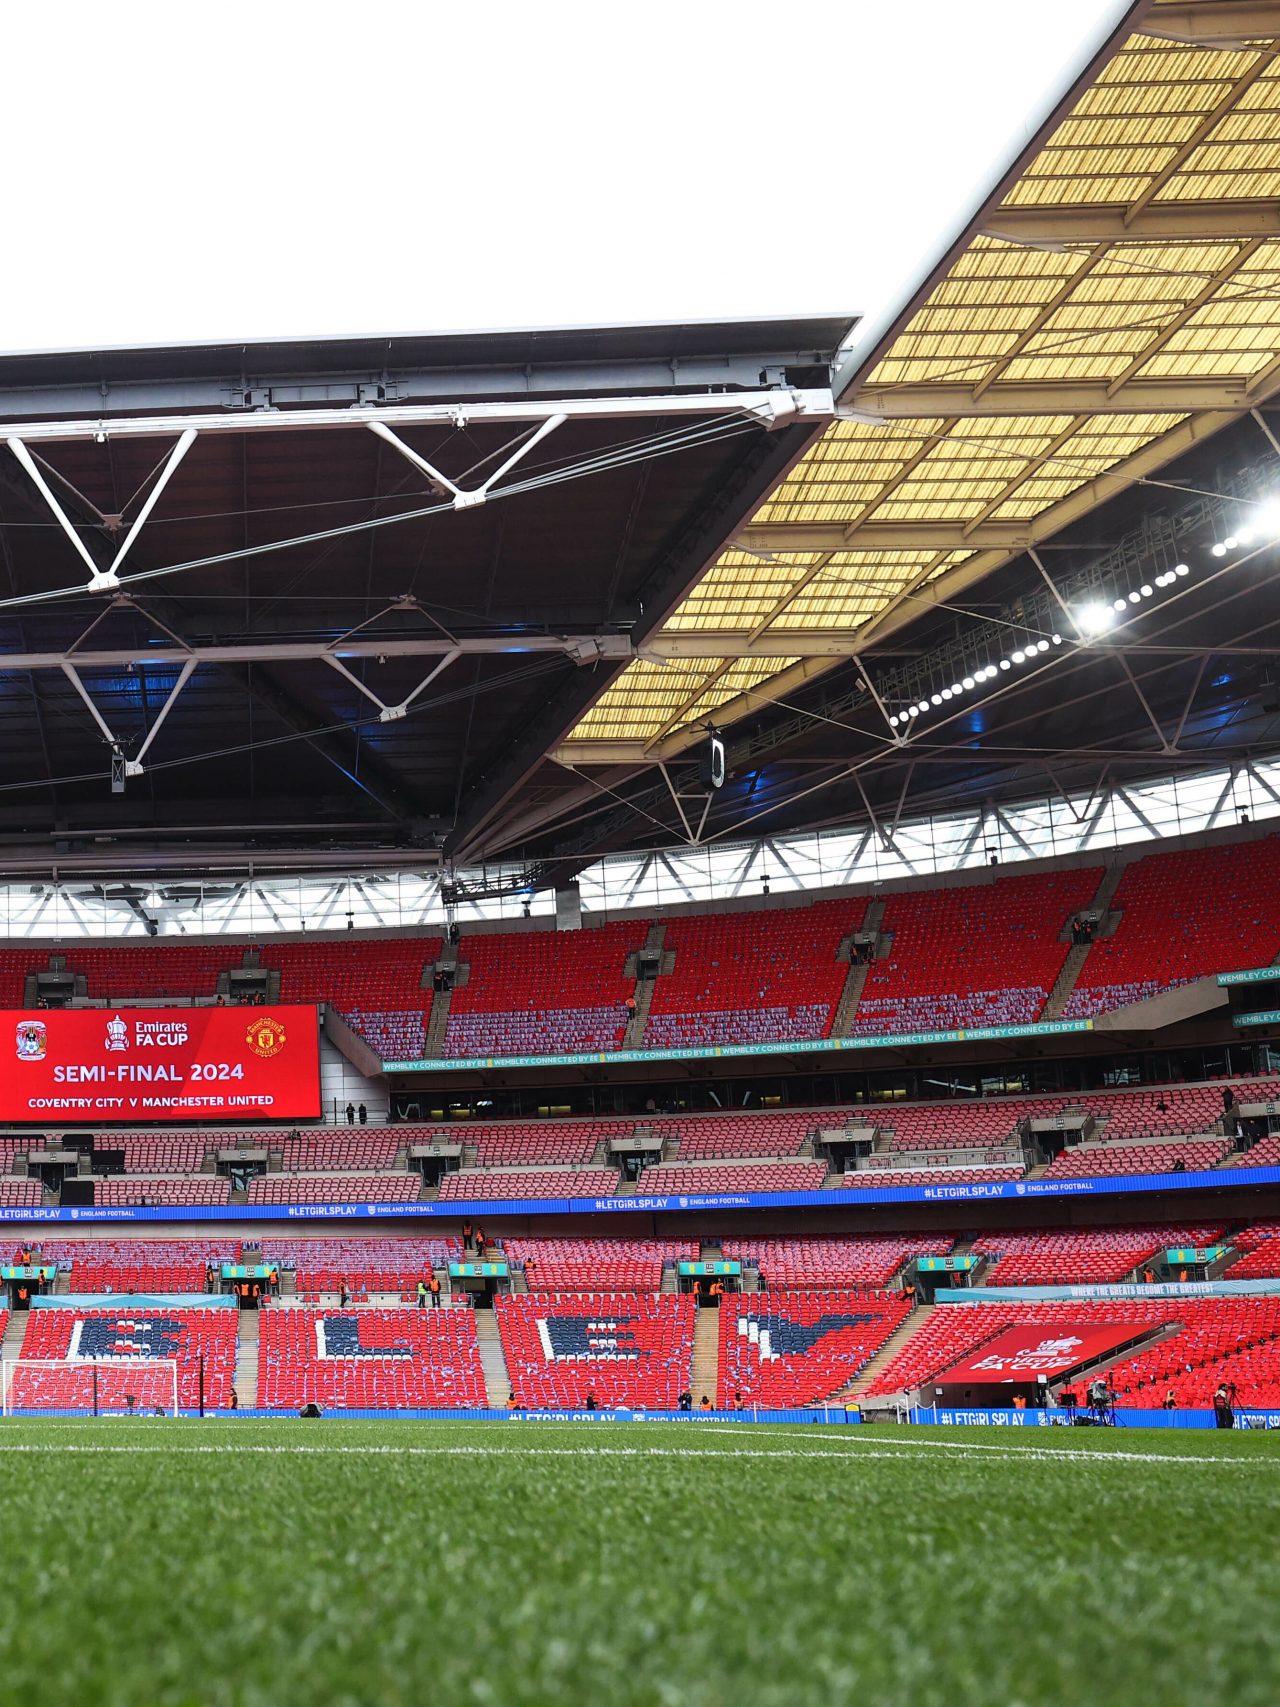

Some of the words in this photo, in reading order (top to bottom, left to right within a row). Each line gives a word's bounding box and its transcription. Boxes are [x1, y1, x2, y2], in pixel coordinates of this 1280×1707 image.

[1219, 972, 1261, 983] WEMBLEY
[1233, 1014, 1275, 1024] WEMBLEY
[136, 1021, 188, 1033] Emirates
[966, 1028, 1006, 1038] WEMBLEY
[1007, 1024, 1060, 1035] CONNECTED
[136, 1034, 154, 1046] FA
[157, 1034, 188, 1046] CUP
[842, 1038, 880, 1047] WEMBLEY
[882, 1034, 933, 1044] CONNECTED
[722, 1046, 760, 1055] WEMBLEY
[761, 1043, 811, 1052] CONNECTED
[494, 1058, 529, 1066] WEMBLEY
[530, 1056, 577, 1064] CONNECTED
[607, 1052, 643, 1061] WEMBLEY
[644, 1050, 692, 1059] CONNECTED
[384, 1062, 418, 1070] WEMBLEY
[420, 1060, 466, 1069] CONNECTED
[53, 1064, 183, 1083] SEMI-FINAL
[190, 1063, 245, 1081] 2024
[28, 1098, 93, 1108] COVENTRY
[95, 1097, 124, 1107] CITY
[129, 1097, 138, 1107] V
[142, 1096, 224, 1107] MANCHESTER
[228, 1095, 274, 1105] UNITED
[1028, 1184, 1059, 1192] ENGLAND
[1060, 1182, 1094, 1190] FOOTBALL
[1071, 1286, 1095, 1297] WHERE
[1097, 1286, 1109, 1296] THE
[1110, 1285, 1135, 1296] GREATS
[1166, 1284, 1179, 1294] THE
[1180, 1282, 1214, 1294] GREATEST
[982, 1355, 1080, 1363] Emirates
[1010, 1361, 1073, 1370] CUP
